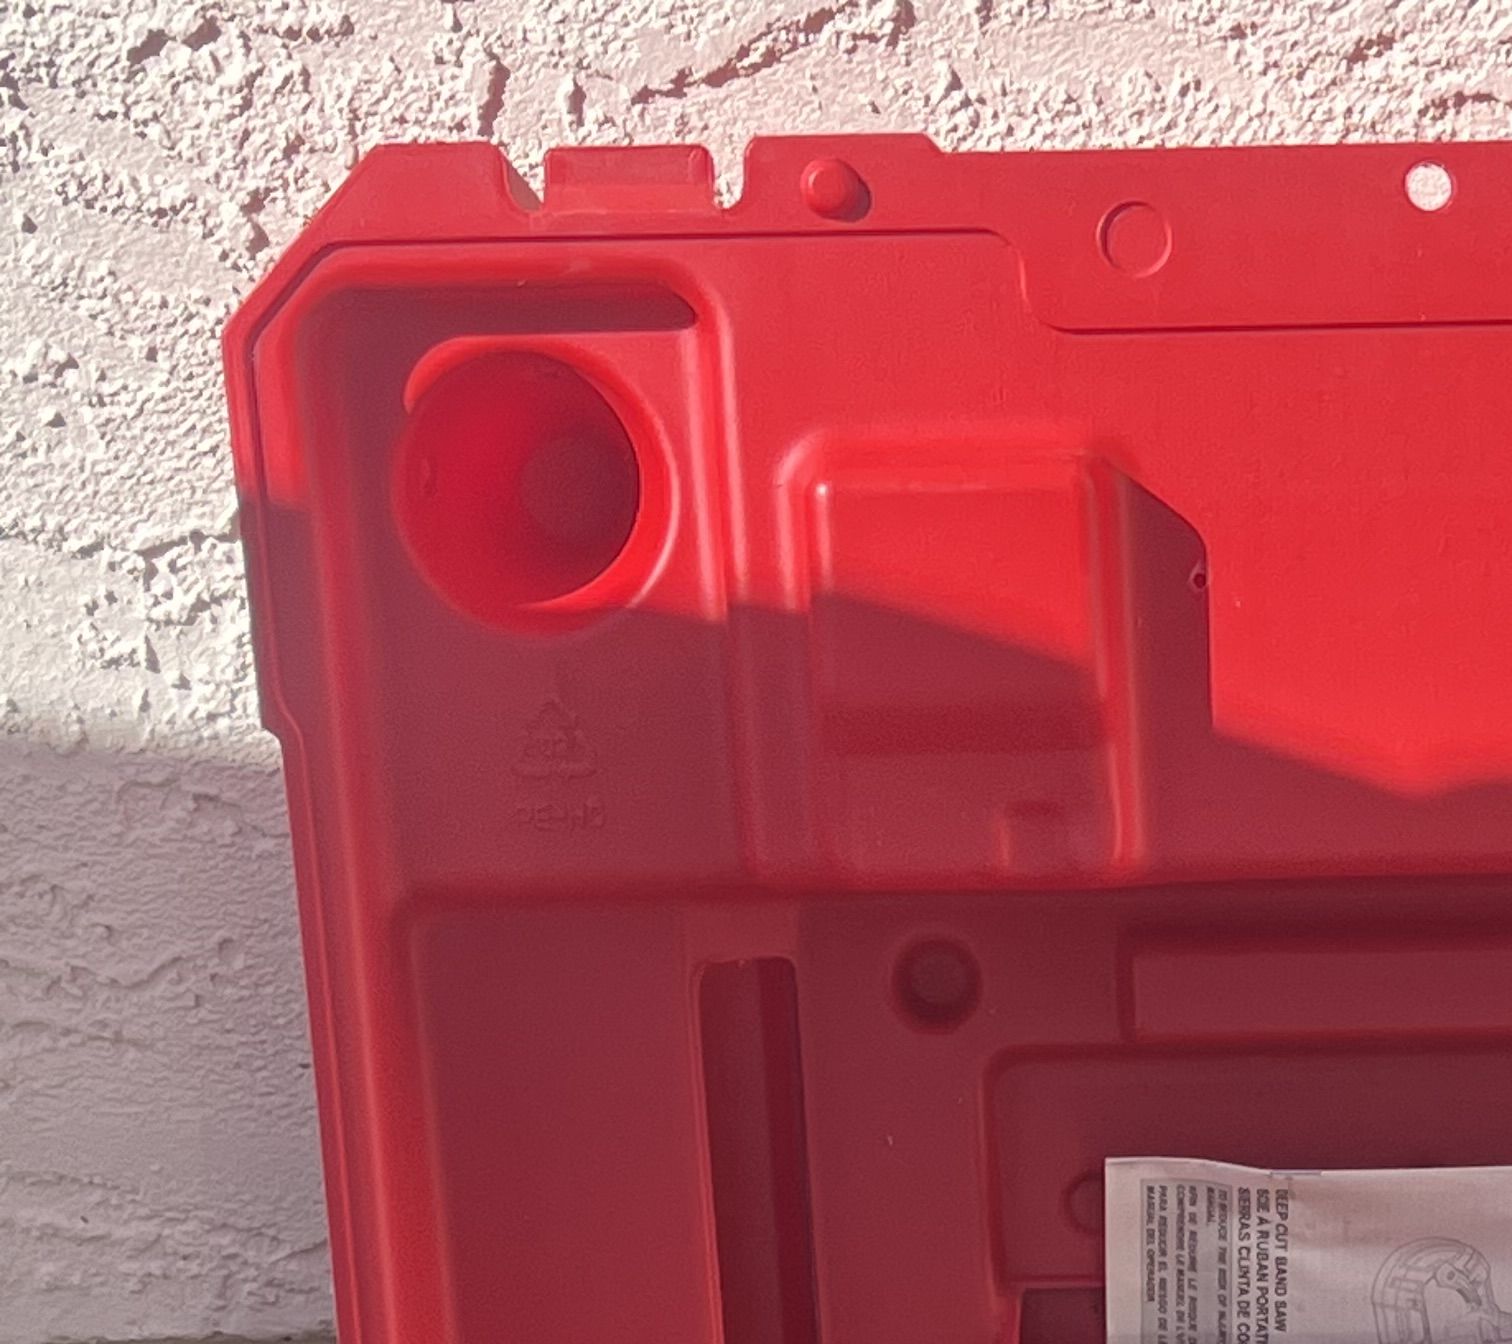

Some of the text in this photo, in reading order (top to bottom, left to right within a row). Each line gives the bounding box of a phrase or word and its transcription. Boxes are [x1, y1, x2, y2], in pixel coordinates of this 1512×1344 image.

[1237, 1187, 1251, 1241] SIERRAS
[1256, 1230, 1269, 1283] RUBAN
[1274, 1189, 1289, 1332] DEEP CUT BAND SAW
[1237, 1301, 1250, 1318] DE
